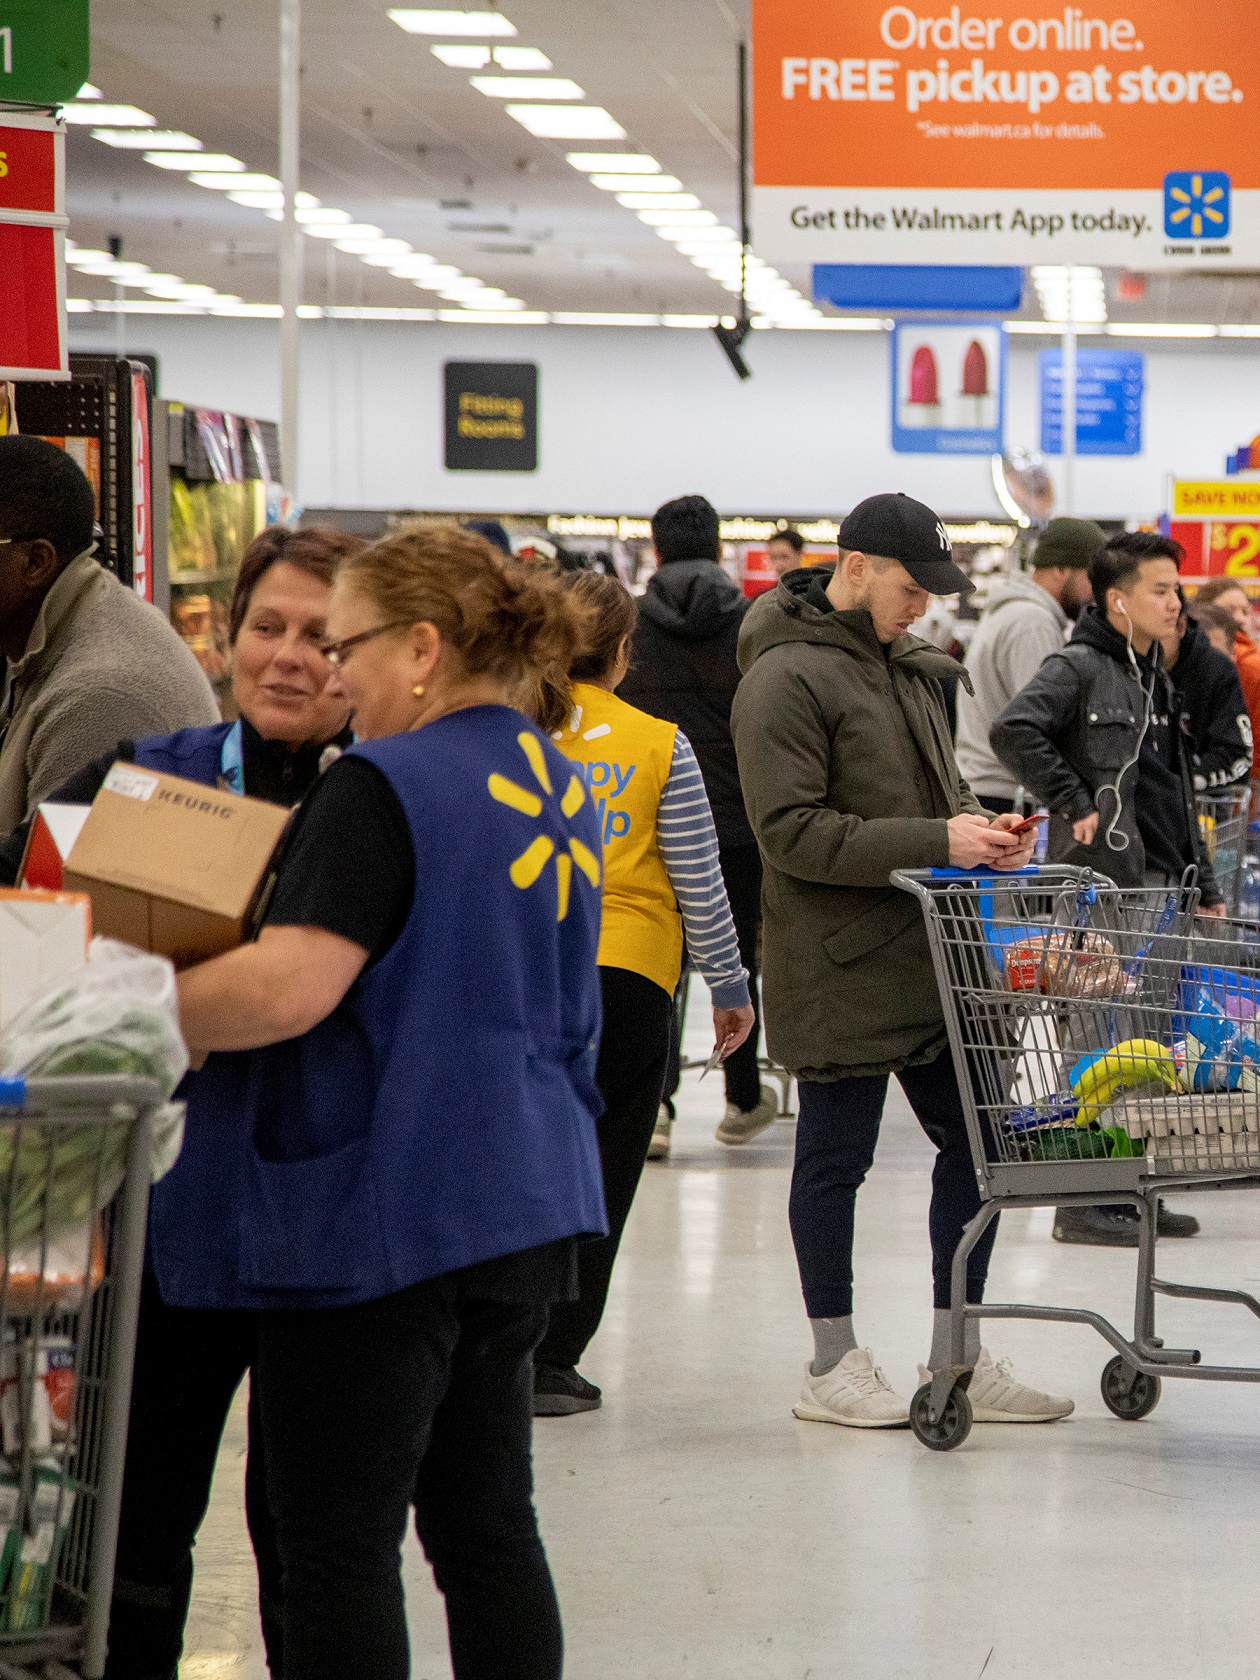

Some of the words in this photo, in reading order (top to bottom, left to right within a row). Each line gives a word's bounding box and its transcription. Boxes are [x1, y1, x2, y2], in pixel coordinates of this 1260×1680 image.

[880, 6, 1003, 50] Order
[1009, 7, 1144, 51] online.
[906, 58, 1060, 114] pickup
[1065, 66, 1112, 104] at
[1118, 66, 1243, 104] store.
[1033, 122, 1053, 139] for
[790, 206, 836, 229] Get
[843, 207, 886, 229] the
[891, 208, 1002, 231] Walmart
[1010, 209, 1064, 237] App
[1071, 209, 1151, 237] today.
[158, 788, 234, 820] KEURIG
